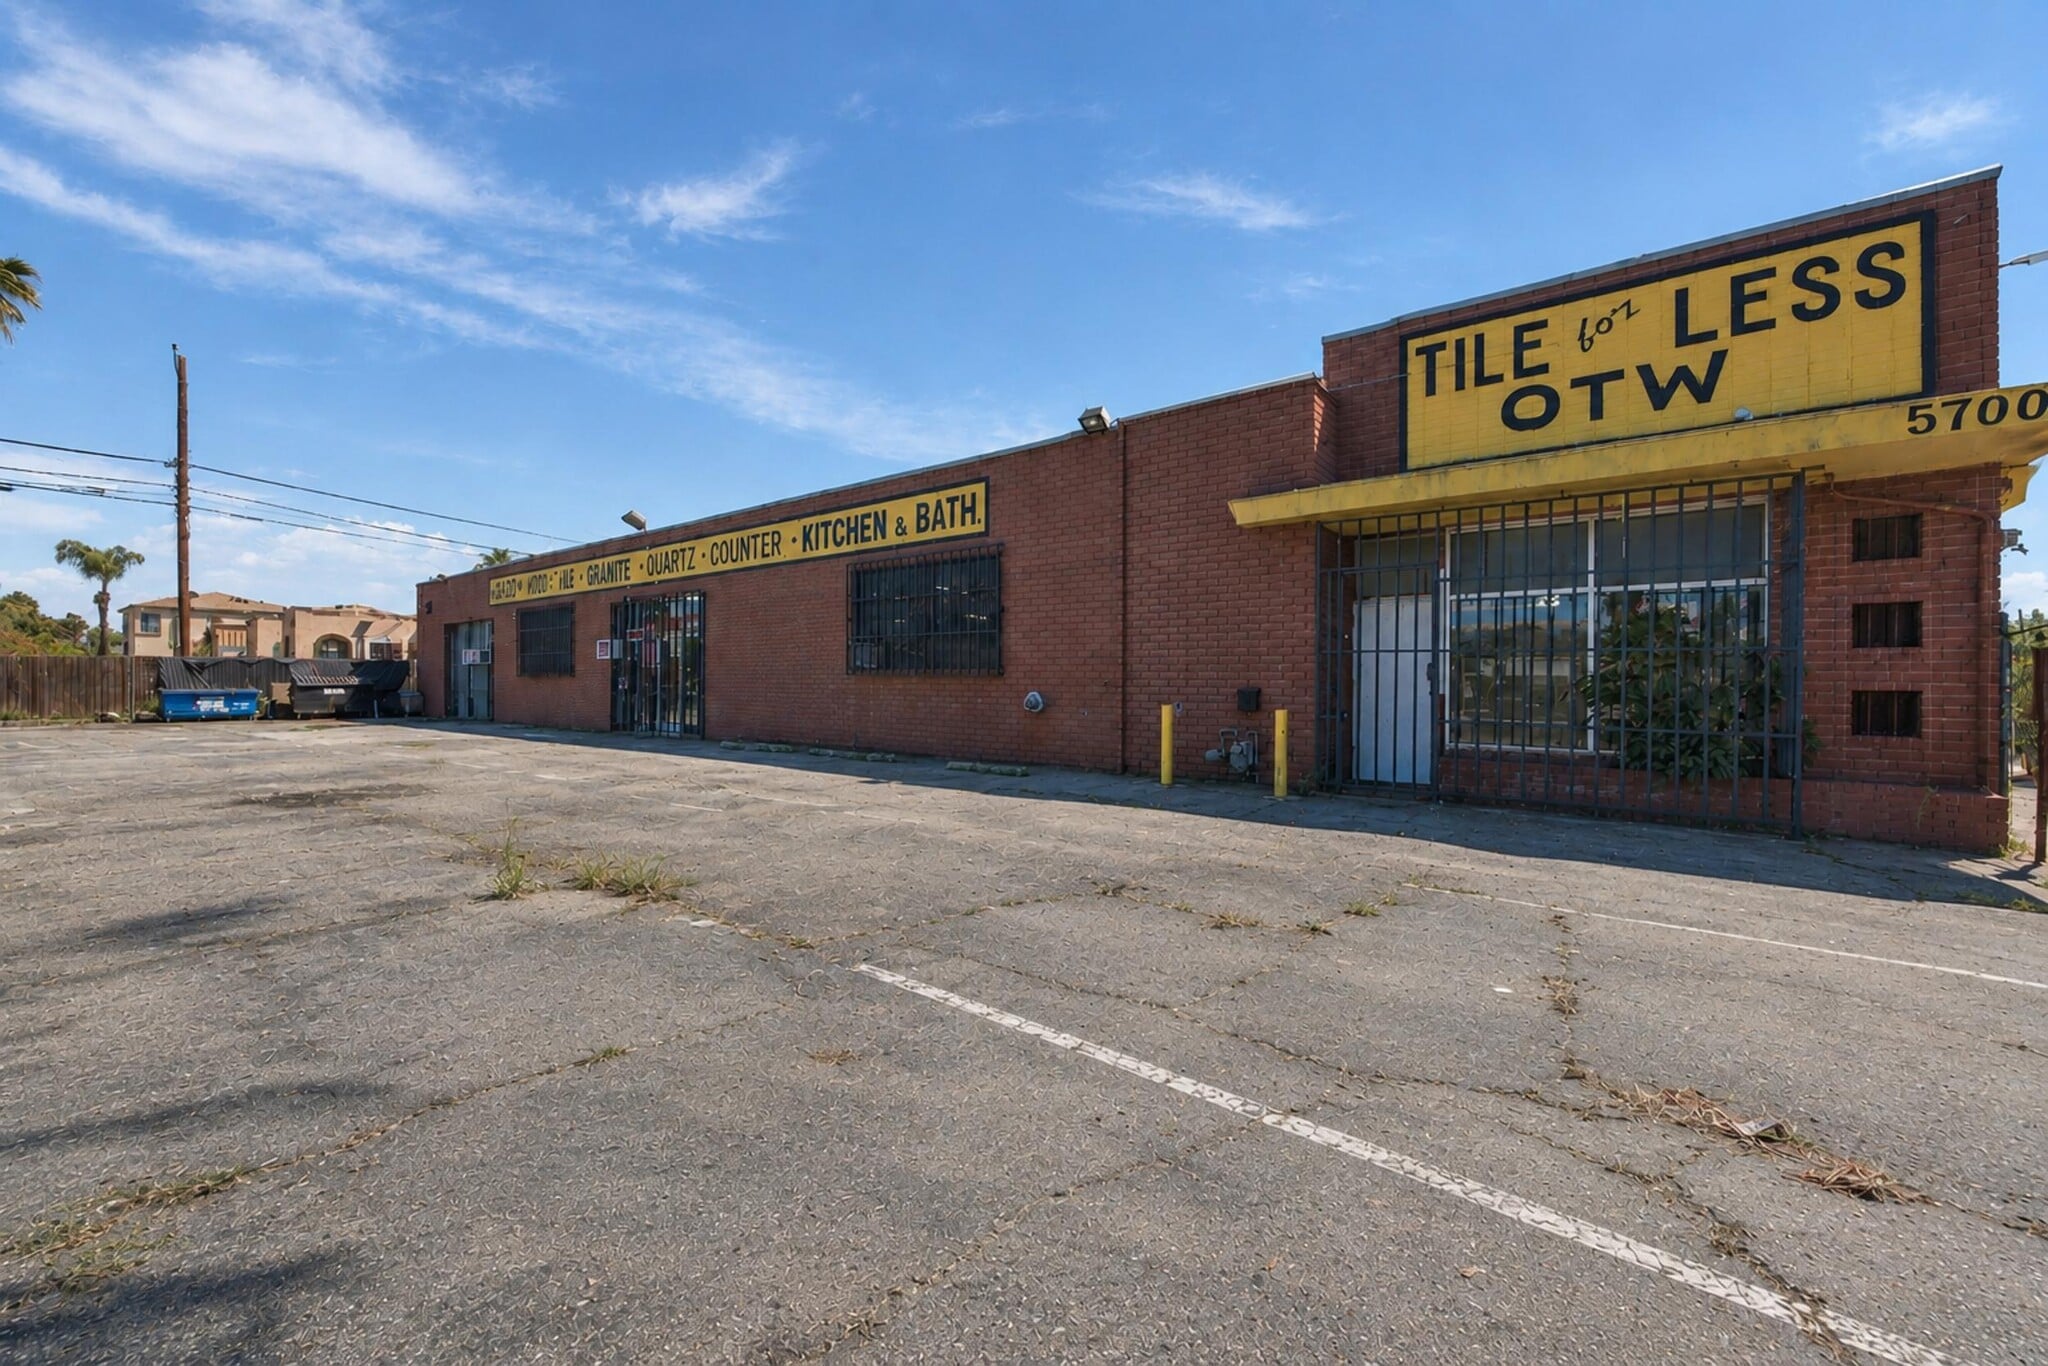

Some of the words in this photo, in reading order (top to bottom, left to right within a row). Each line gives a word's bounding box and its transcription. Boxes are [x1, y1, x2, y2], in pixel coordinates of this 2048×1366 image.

[1415, 318, 1550, 398] TILE
[1674, 240, 1907, 349] LESS
[1500, 348, 1729, 433] OTW
[1907, 388, 2048, 436] 5700
[586, 557, 631, 586] GRANITE
[646, 546, 696, 578] QUARTZ
[710, 530, 782, 567] COUNTER
[801, 509, 887, 553] KITCHEN
[894, 516, 908, 537] &
